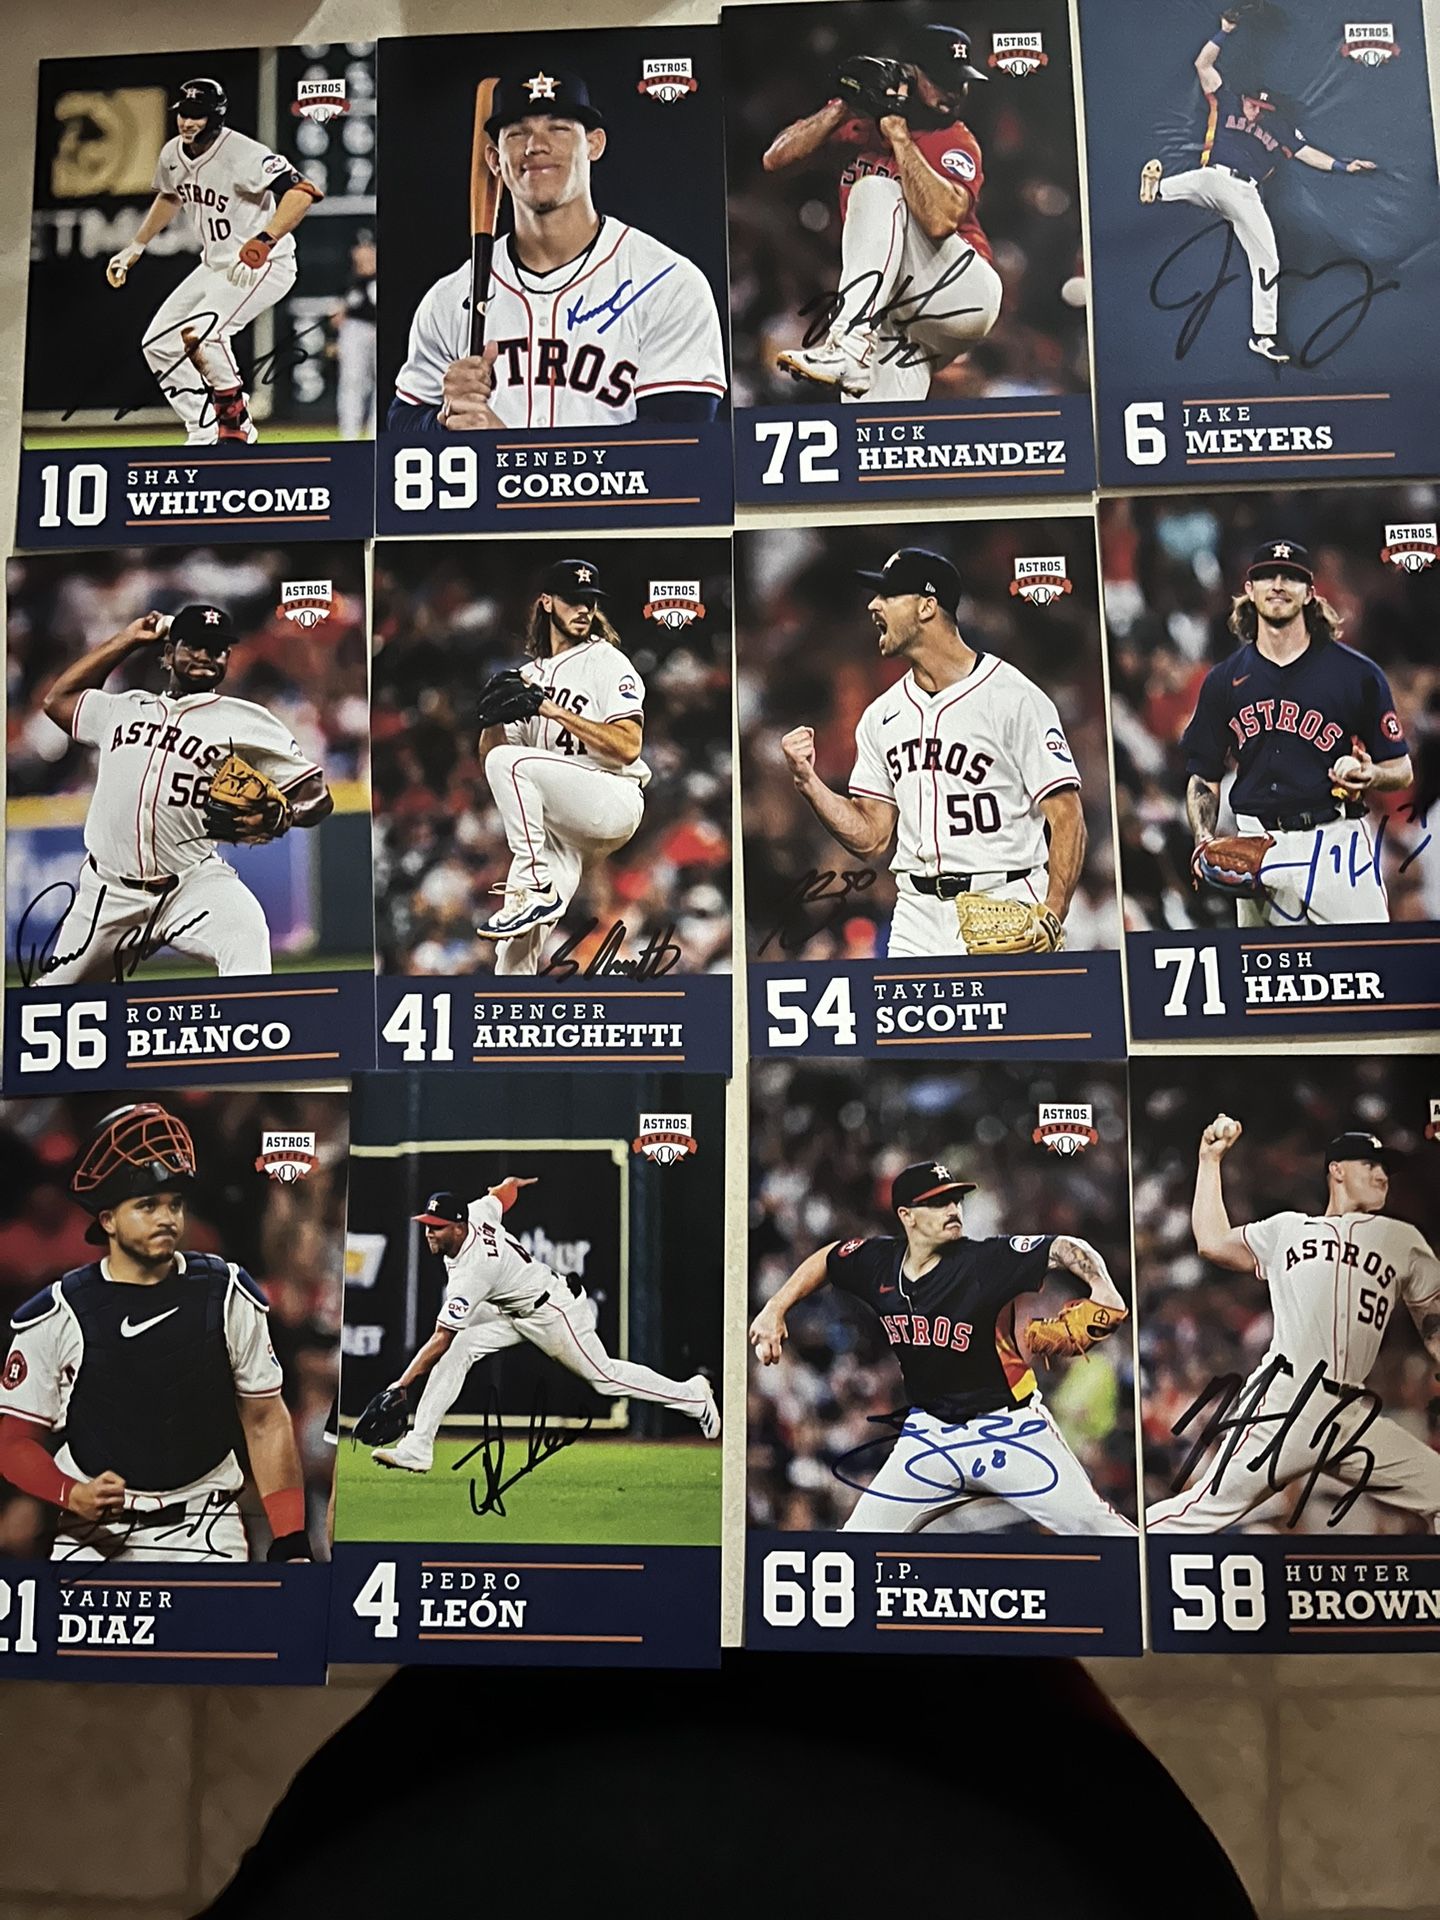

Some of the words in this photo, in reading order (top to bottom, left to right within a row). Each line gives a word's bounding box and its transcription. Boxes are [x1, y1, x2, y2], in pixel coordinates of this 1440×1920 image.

[996, 37, 1037, 47] ASTROS
[1348, 27, 1389, 38] ASTROS
[953, 43, 967, 59] H
[646, 62, 688, 73] ASTROS
[300, 82, 342, 95] ASTROS
[943, 158, 975, 173] OXY
[208, 217, 231, 241] 10
[1183, 407, 1250, 427] JAKE
[856, 426, 926, 442] NICK
[1123, 401, 1167, 466] 6
[1185, 426, 1334, 456] MEYERS
[496, 450, 607, 467] KENEDY
[755, 420, 840, 484] 72
[857, 441, 1067, 472] HERNANDEZ
[128, 469, 199, 486] SHAY
[394, 446, 478, 511] 89
[497, 470, 650, 499] CORONA
[39, 464, 107, 528] 10
[127, 487, 331, 516] WHITCOMB
[1389, 528, 1432, 540] ASTROS
[1273, 544, 1290, 559] H
[578, 569, 591, 583] H
[1018, 560, 1060, 572] ASTROS
[284, 585, 327, 597] ASTROS
[653, 585, 695, 596] ASTROS
[205, 611, 219, 625] H
[110, 721, 221, 770] ASTROS
[168, 772, 211, 809] 56
[946, 792, 1002, 837] 50
[1241, 952, 1313, 973] JOSH
[874, 981, 985, 1000] TAYLER
[1154, 946, 1226, 1017] 71
[1245, 971, 1385, 1004] HADER
[126, 1006, 221, 1023] RONEL
[473, 1003, 606, 1020] SPENCER
[766, 976, 857, 1048] 54
[876, 1003, 1007, 1034] SCOTT
[20, 1001, 107, 1073] 56
[382, 993, 454, 1062] 41
[472, 1023, 683, 1048] ARRIGHETTI
[126, 1022, 291, 1057] BLANCO
[643, 1118, 688, 1130] ASTROS
[1043, 1108, 1088, 1120] ASTROS
[266, 1136, 309, 1148] ASTROS
[428, 1199, 438, 1212] H
[1286, 1239, 1397, 1289] ASTROS
[449, 1301, 470, 1312] OXY
[1358, 1288, 1389, 1331] 58
[9, 1363, 20, 1380] H
[971, 1449, 1007, 1478] 68
[420, 1572, 521, 1591] PEDRO
[874, 1562, 919, 1584] J.P.
[1285, 1565, 1410, 1582] HUNTER
[59, 1589, 172, 1608] YAINER
[352, 1561, 400, 1638] 4
[762, 1550, 855, 1628] 68
[1170, 1553, 1267, 1631] 58
[419, 1592, 527, 1628] LEÓN
[876, 1589, 1047, 1620] FRANCE
[1287, 1589, 1440, 1620] BROWN
[57, 1613, 156, 1645] DIAZ
